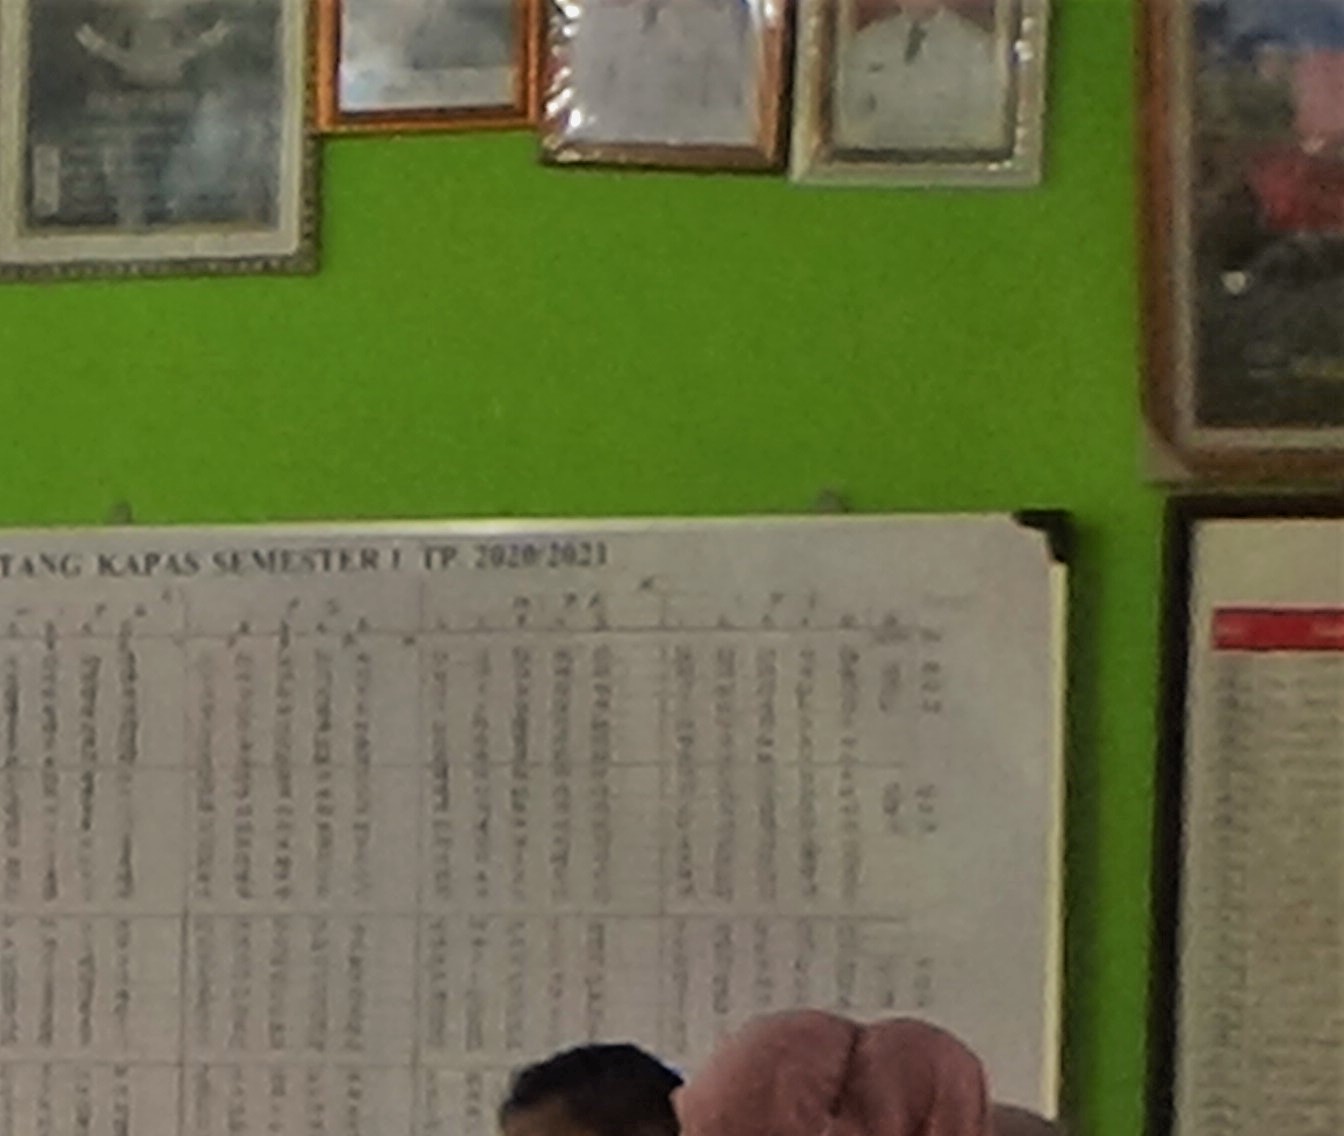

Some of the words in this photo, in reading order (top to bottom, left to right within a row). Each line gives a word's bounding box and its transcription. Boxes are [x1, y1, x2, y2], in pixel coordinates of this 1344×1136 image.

[97, 551, 201, 577] KAPAS
[213, 548, 378, 575] SEMESTER
[474, 541, 609, 569] 2020/2021
